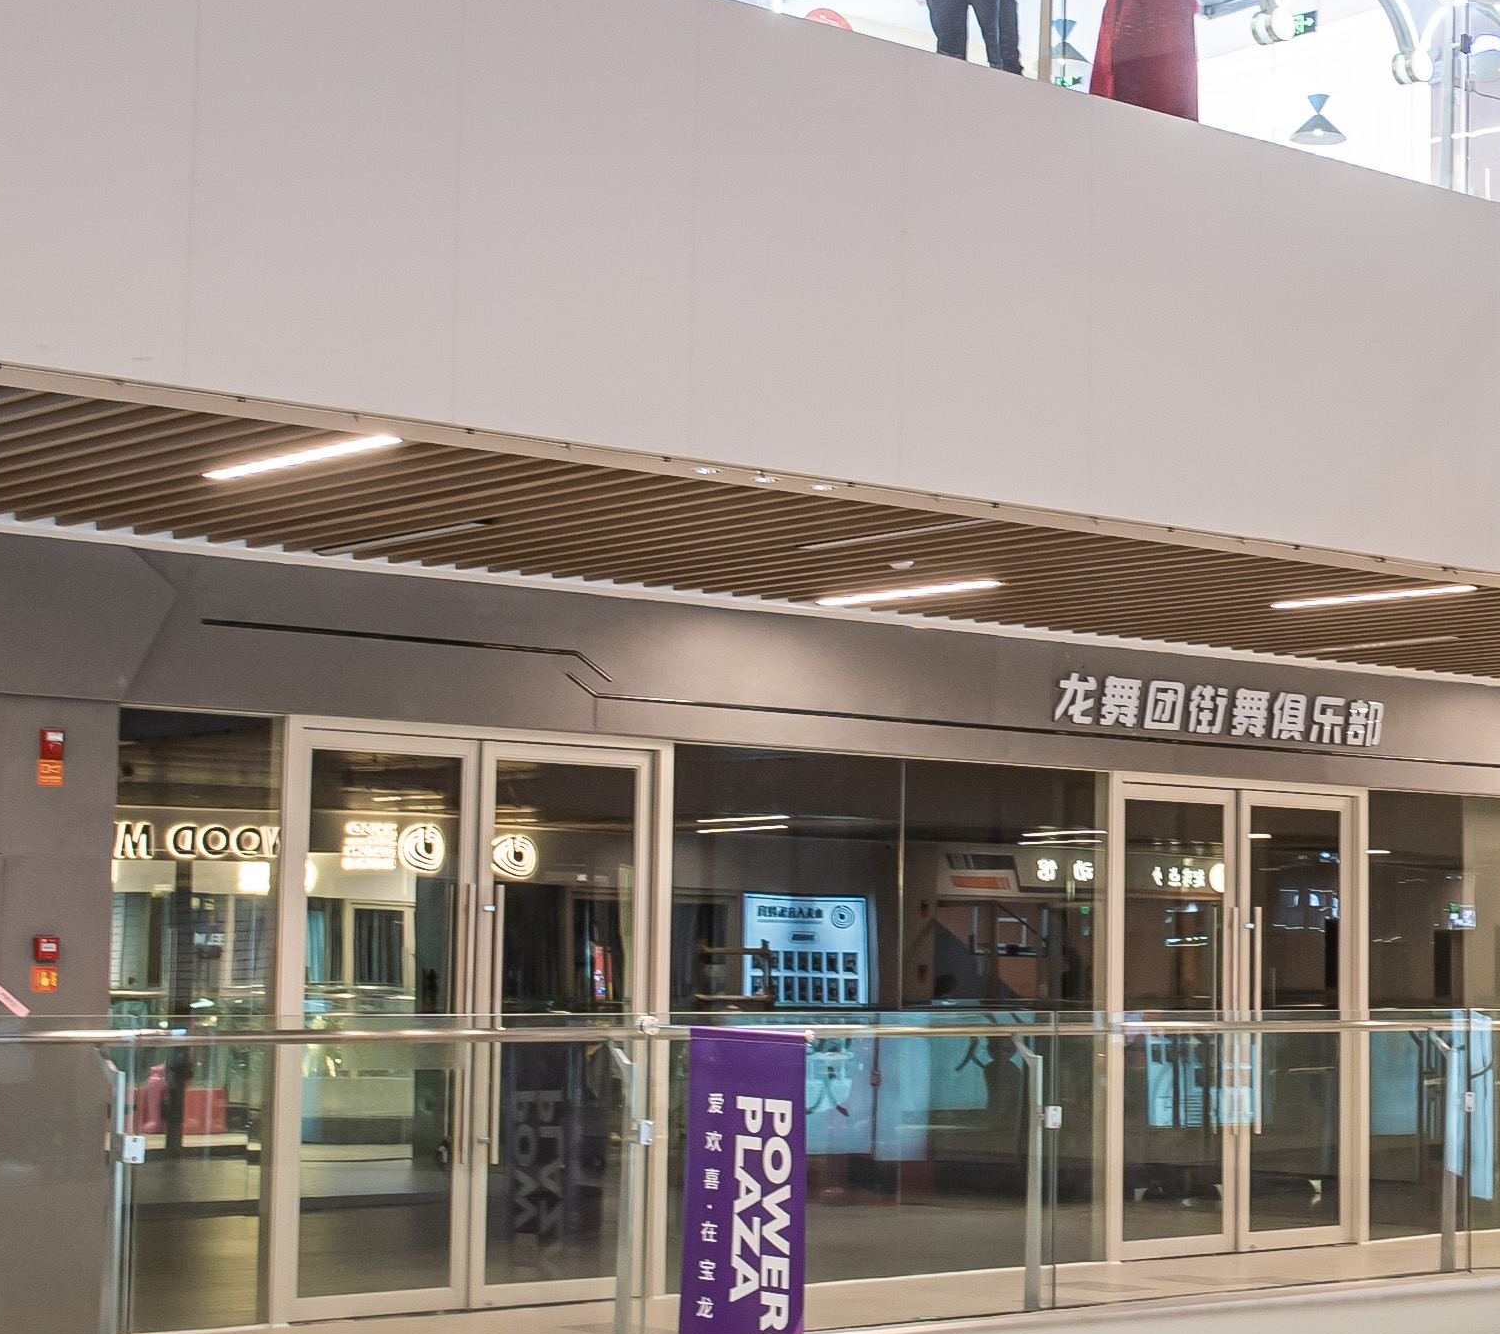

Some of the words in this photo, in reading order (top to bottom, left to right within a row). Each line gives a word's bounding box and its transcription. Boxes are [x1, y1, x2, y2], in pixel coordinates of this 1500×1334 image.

[1054, 672, 1386, 747] 龙舞团街舞俱乐部
[728, 1095, 763, 1303] PLAZA
